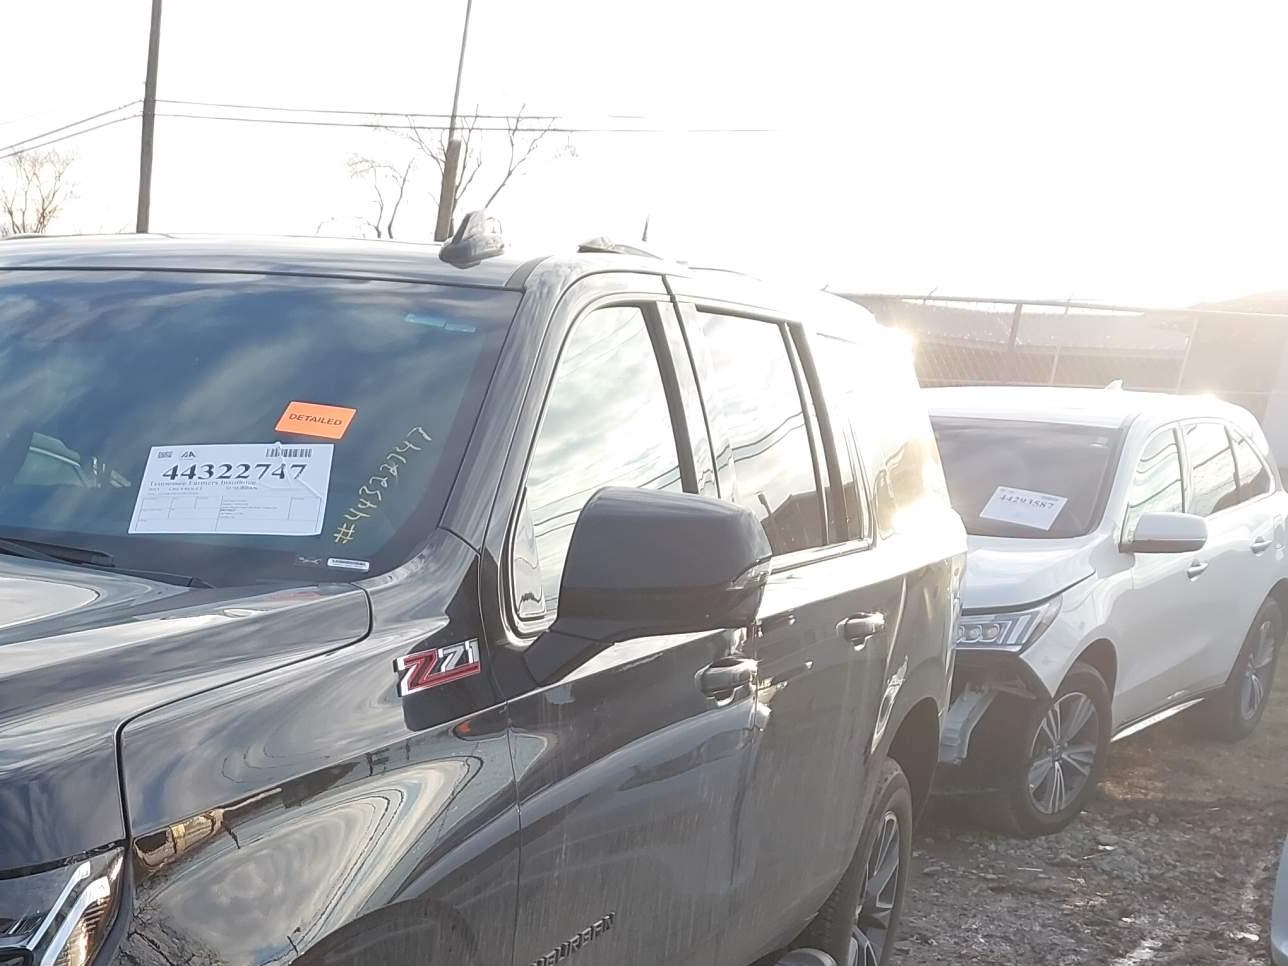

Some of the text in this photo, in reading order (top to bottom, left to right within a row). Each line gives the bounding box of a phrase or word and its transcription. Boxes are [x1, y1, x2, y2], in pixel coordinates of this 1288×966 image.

[289, 413, 343, 426] DETAILED
[162, 463, 307, 481] 44322747
[393, 638, 481, 697] Z71
